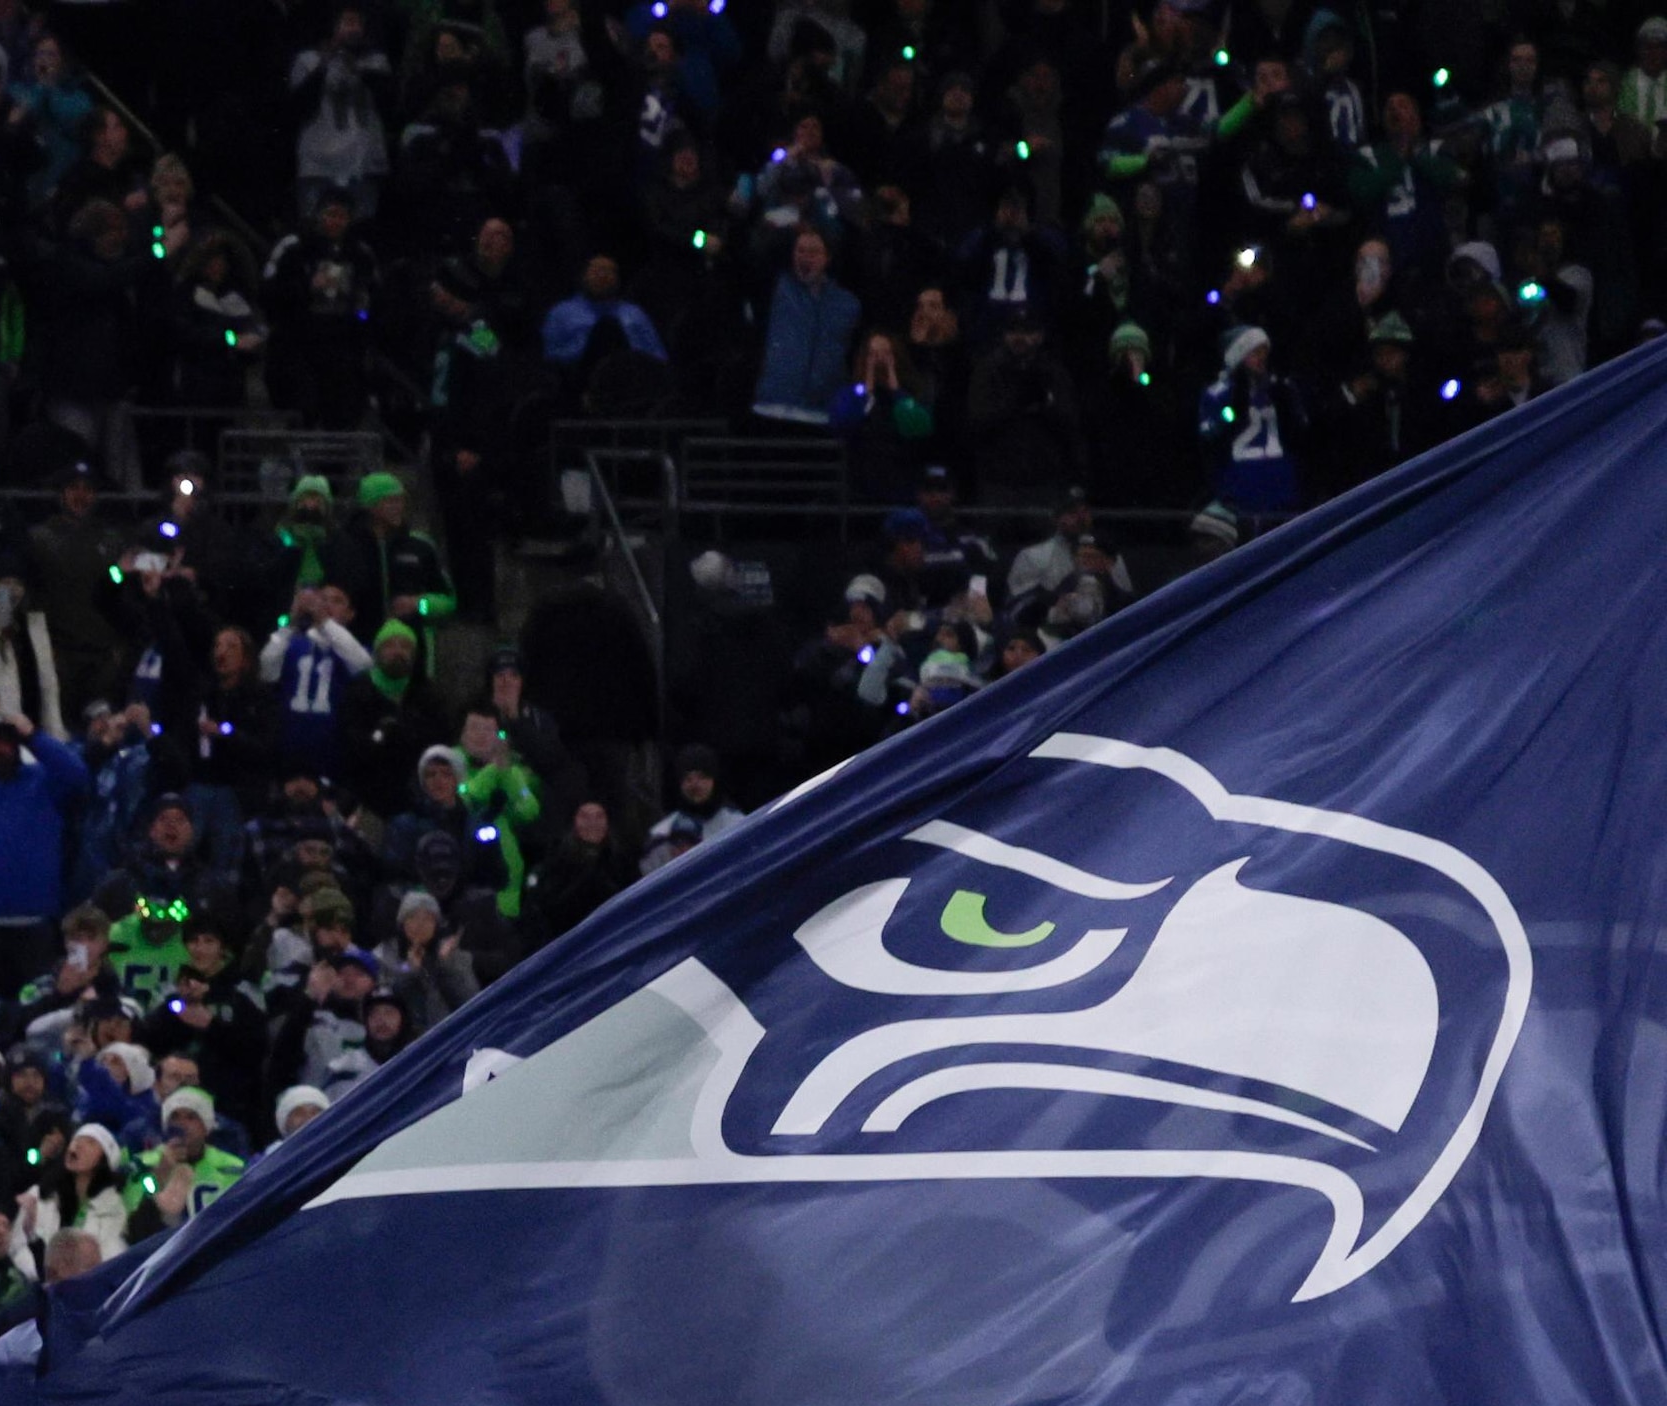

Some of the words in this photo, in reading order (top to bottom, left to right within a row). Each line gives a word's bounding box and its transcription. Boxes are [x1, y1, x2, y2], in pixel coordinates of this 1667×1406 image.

[988, 248, 1028, 301] 11
[1232, 405, 1284, 462] 21
[291, 654, 334, 713] 11
